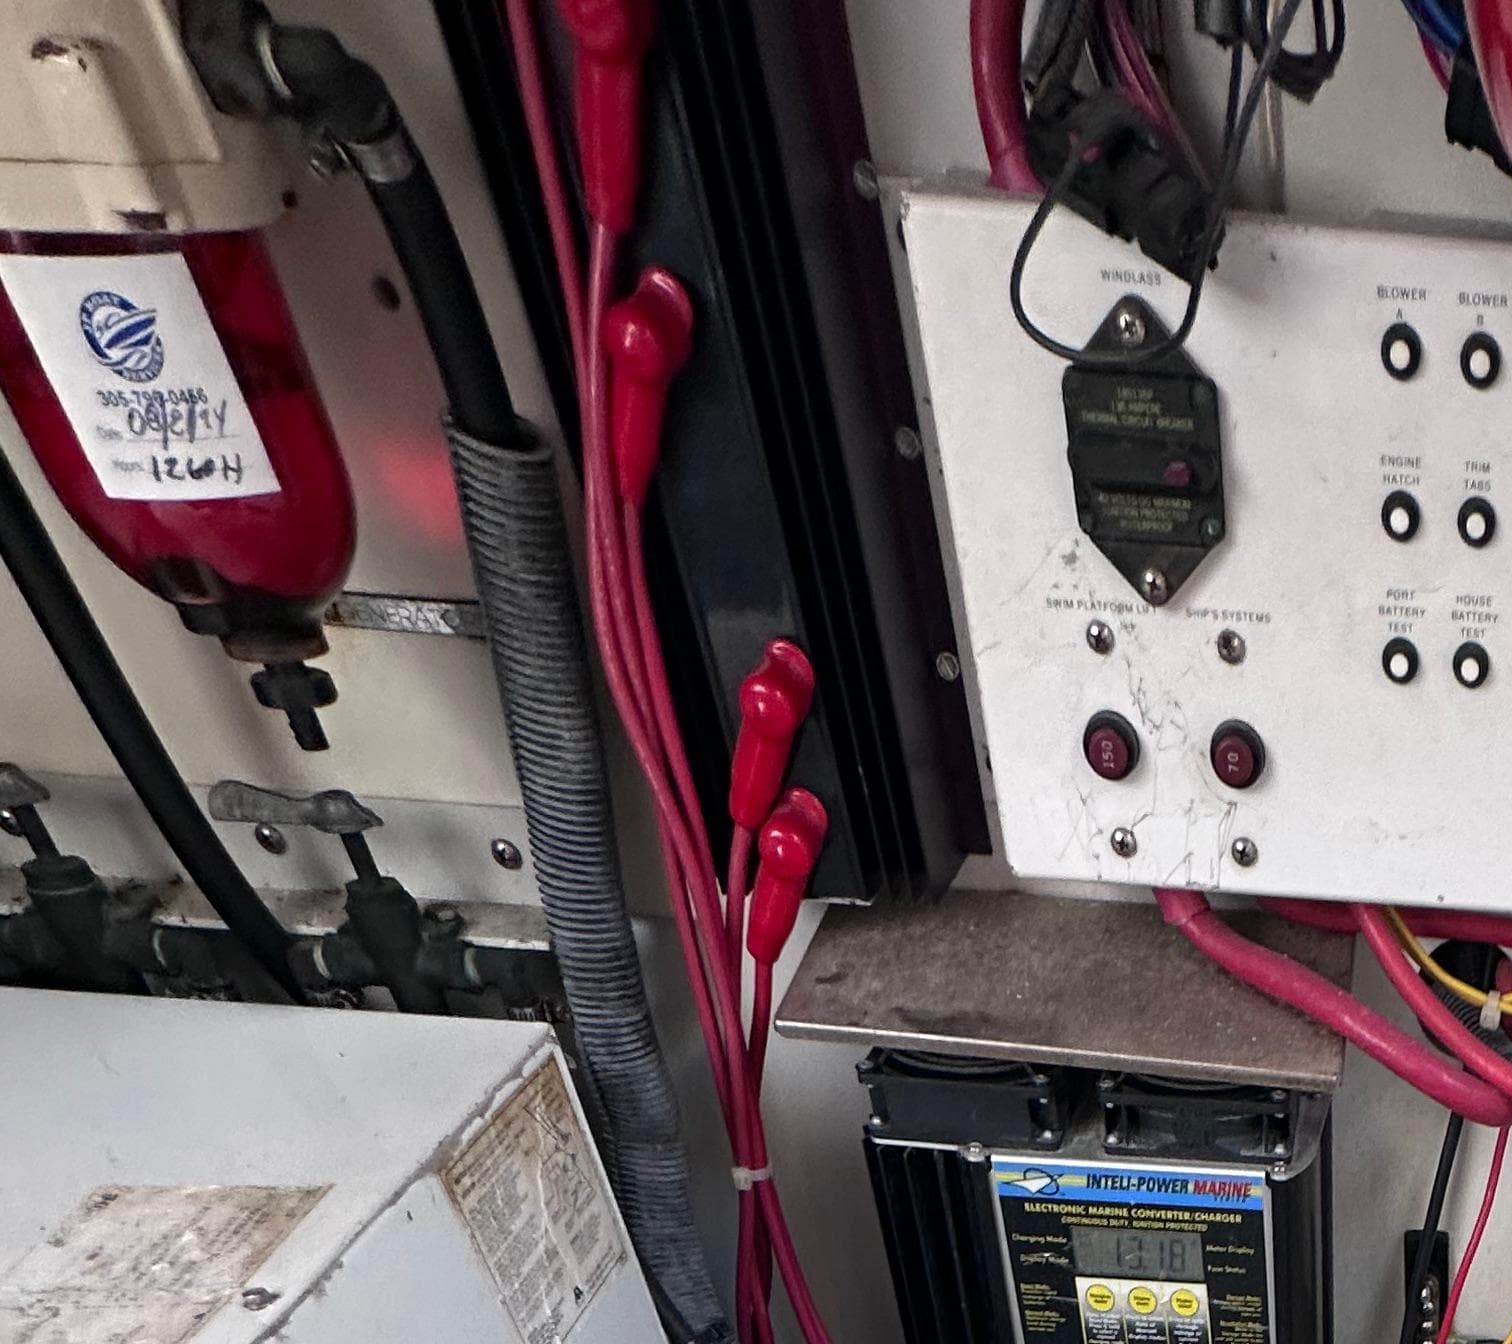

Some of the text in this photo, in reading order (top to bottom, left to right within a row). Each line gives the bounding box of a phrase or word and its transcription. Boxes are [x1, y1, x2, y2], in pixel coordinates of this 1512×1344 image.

[1100, 268, 1162, 287] WINDLASS
[1376, 286, 1427, 301] BLOWER
[1458, 292, 1509, 308] BLOWER
[1380, 455, 1421, 470] ENGINE
[1464, 461, 1491, 475] TRIM
[1382, 474, 1421, 487] HATCH
[1463, 479, 1492, 493] TABS
[1386, 589, 1416, 602] PORT
[1456, 595, 1494, 608] HOUSE
[1077, 599, 1134, 615] PLATFORM
[1378, 605, 1426, 619] BATTERY
[1221, 609, 1272, 625] SYSTEMS
[1451, 610, 1499, 625] BATTERY
[1388, 622, 1414, 634] TEST
[1460, 627, 1487, 640] TEST
[1086, 1173, 1252, 1198] INTELI-POWER MARINE
[1024, 1202, 1242, 1224] ELECTRONIC MARINE CONVERTER/CHARGER
[1012, 1232, 1047, 1245] Charging
